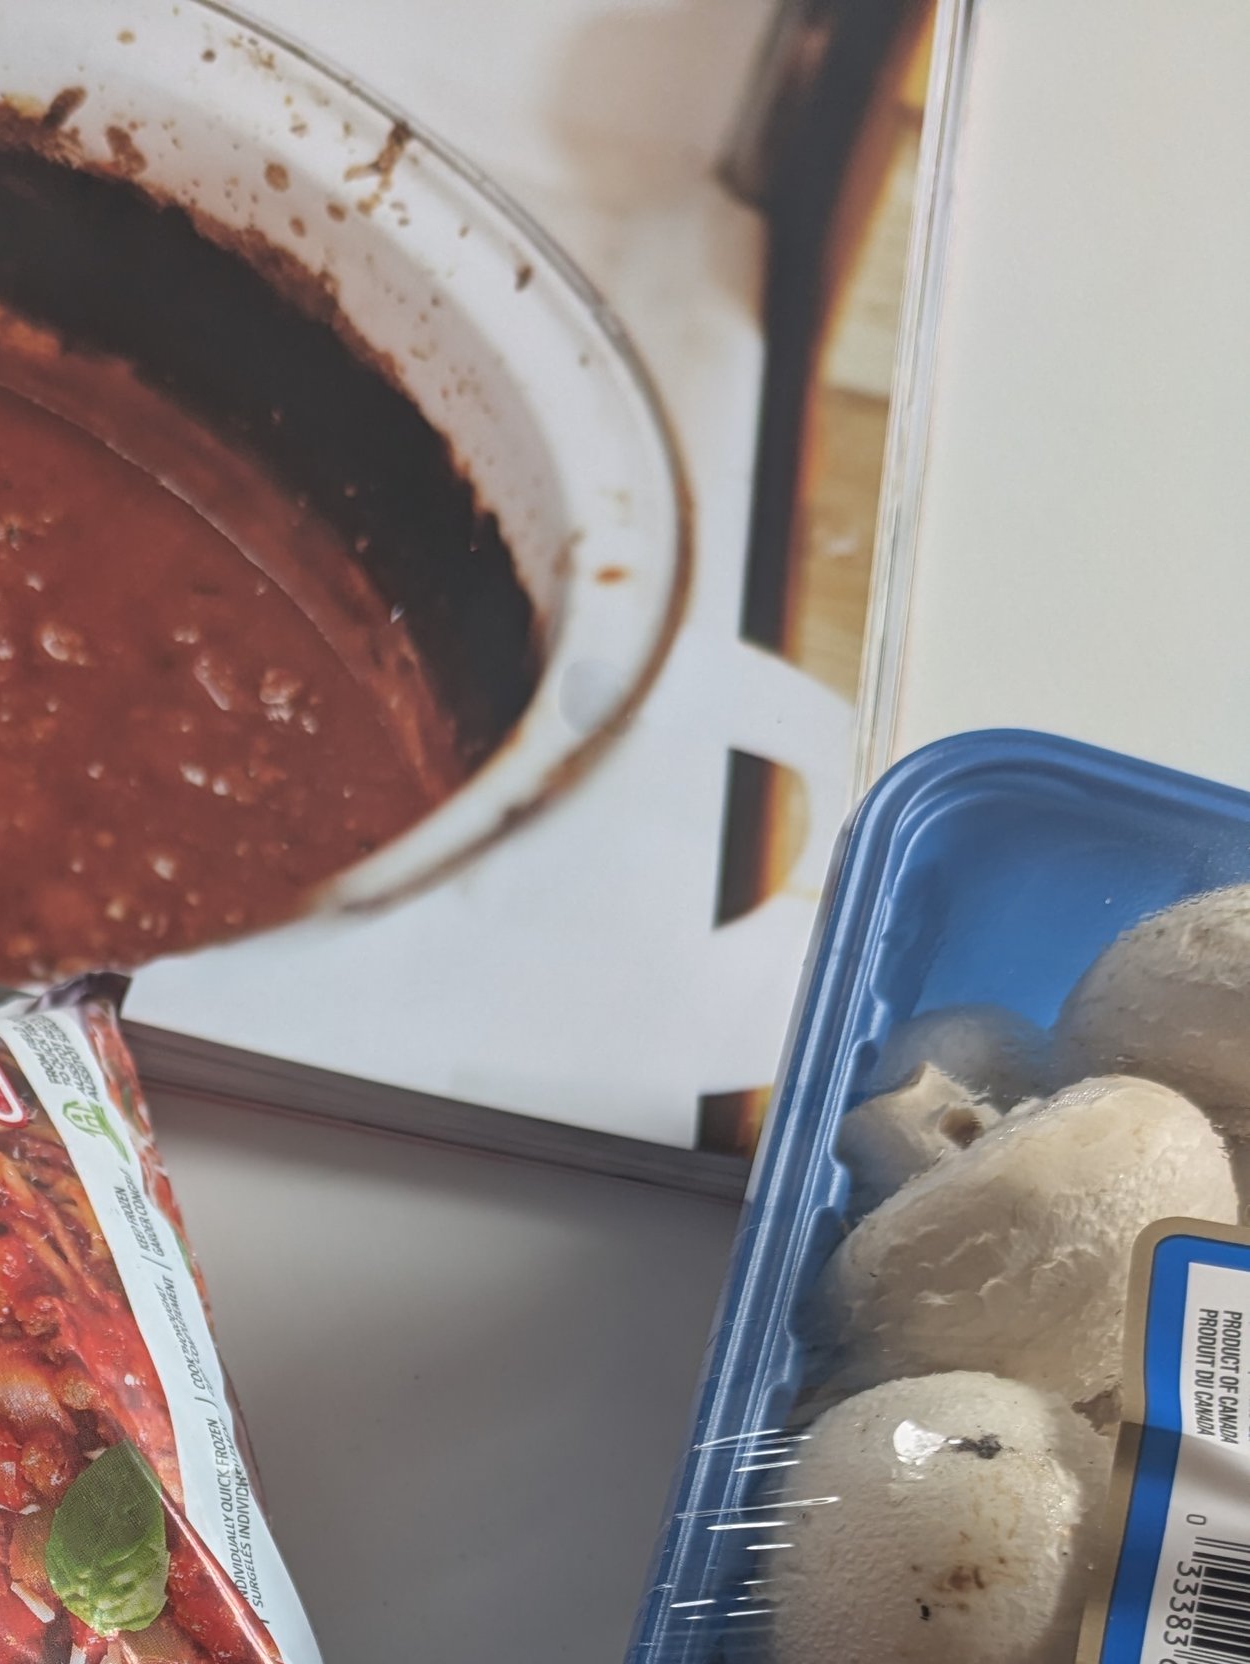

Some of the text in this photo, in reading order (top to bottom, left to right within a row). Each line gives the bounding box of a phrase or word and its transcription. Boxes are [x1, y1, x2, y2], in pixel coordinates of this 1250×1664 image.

[184, 1358, 206, 1390] COOK
[1194, 1308, 1219, 1436] PRODUIT DU CANADA
[1218, 1310, 1243, 1445] PRODUCT OF CANADA
[207, 1418, 231, 1468] FROZEN
[217, 1469, 233, 1513] QUICK
[1163, 1561, 1203, 1647] 33383
